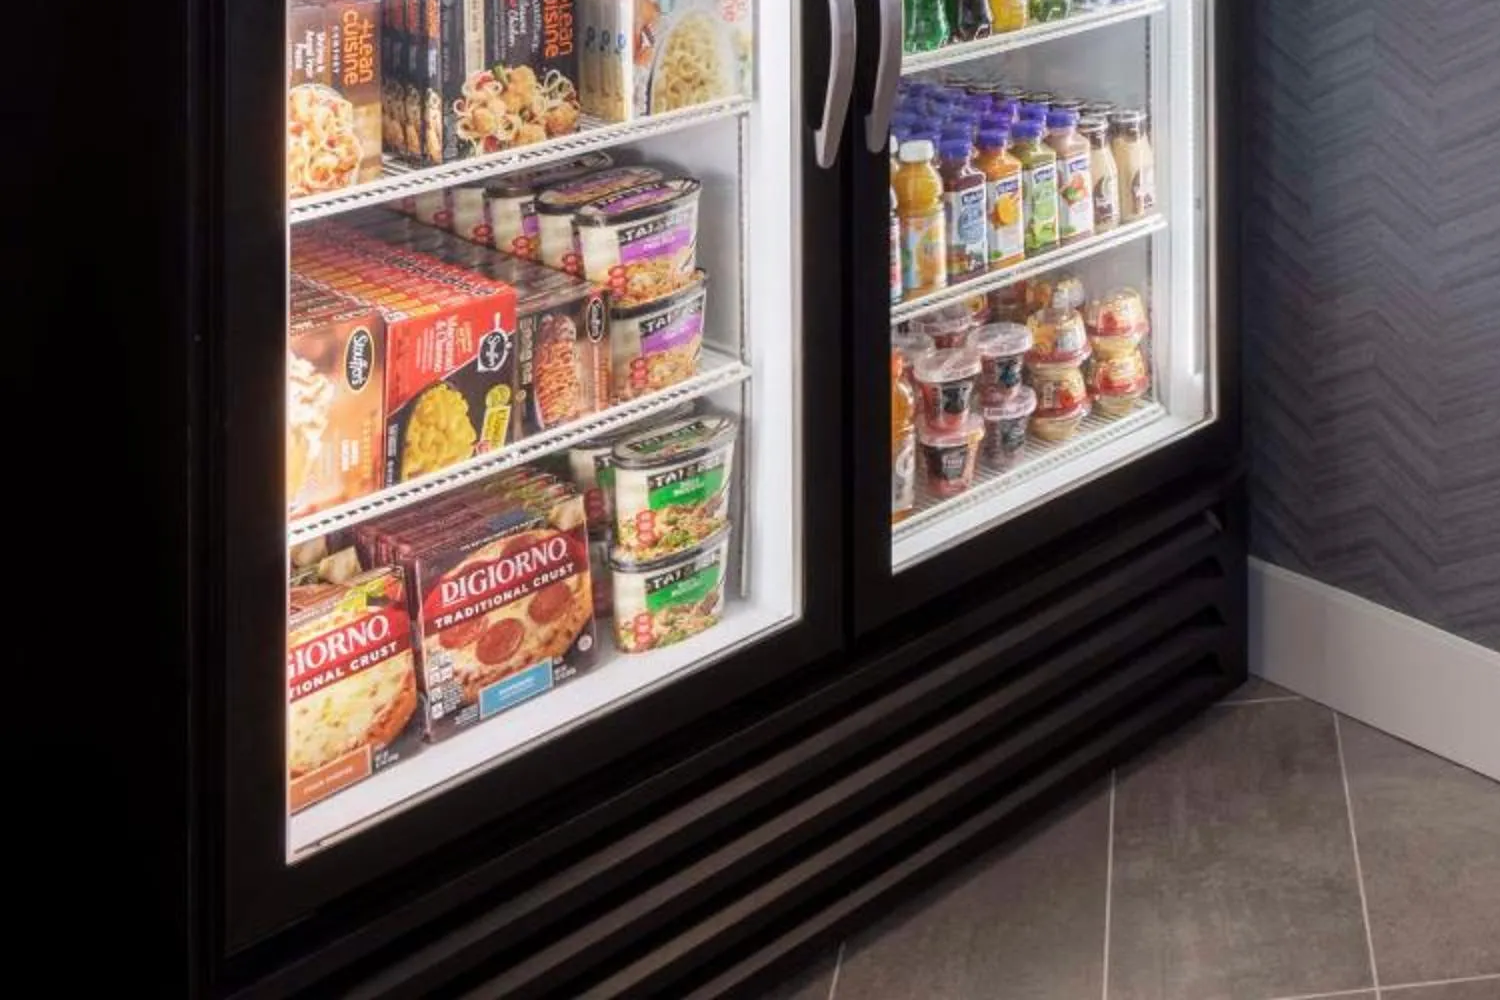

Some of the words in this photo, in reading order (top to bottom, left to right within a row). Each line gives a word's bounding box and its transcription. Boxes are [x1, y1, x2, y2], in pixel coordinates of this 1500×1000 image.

[343, 10, 360, 87] cuisine
[434, 583, 529, 629] TRADITIONAL
[532, 563, 575, 588] CRUST
[440, 536, 569, 608] DIGIORNO
[350, 641, 398, 670] CRUST
